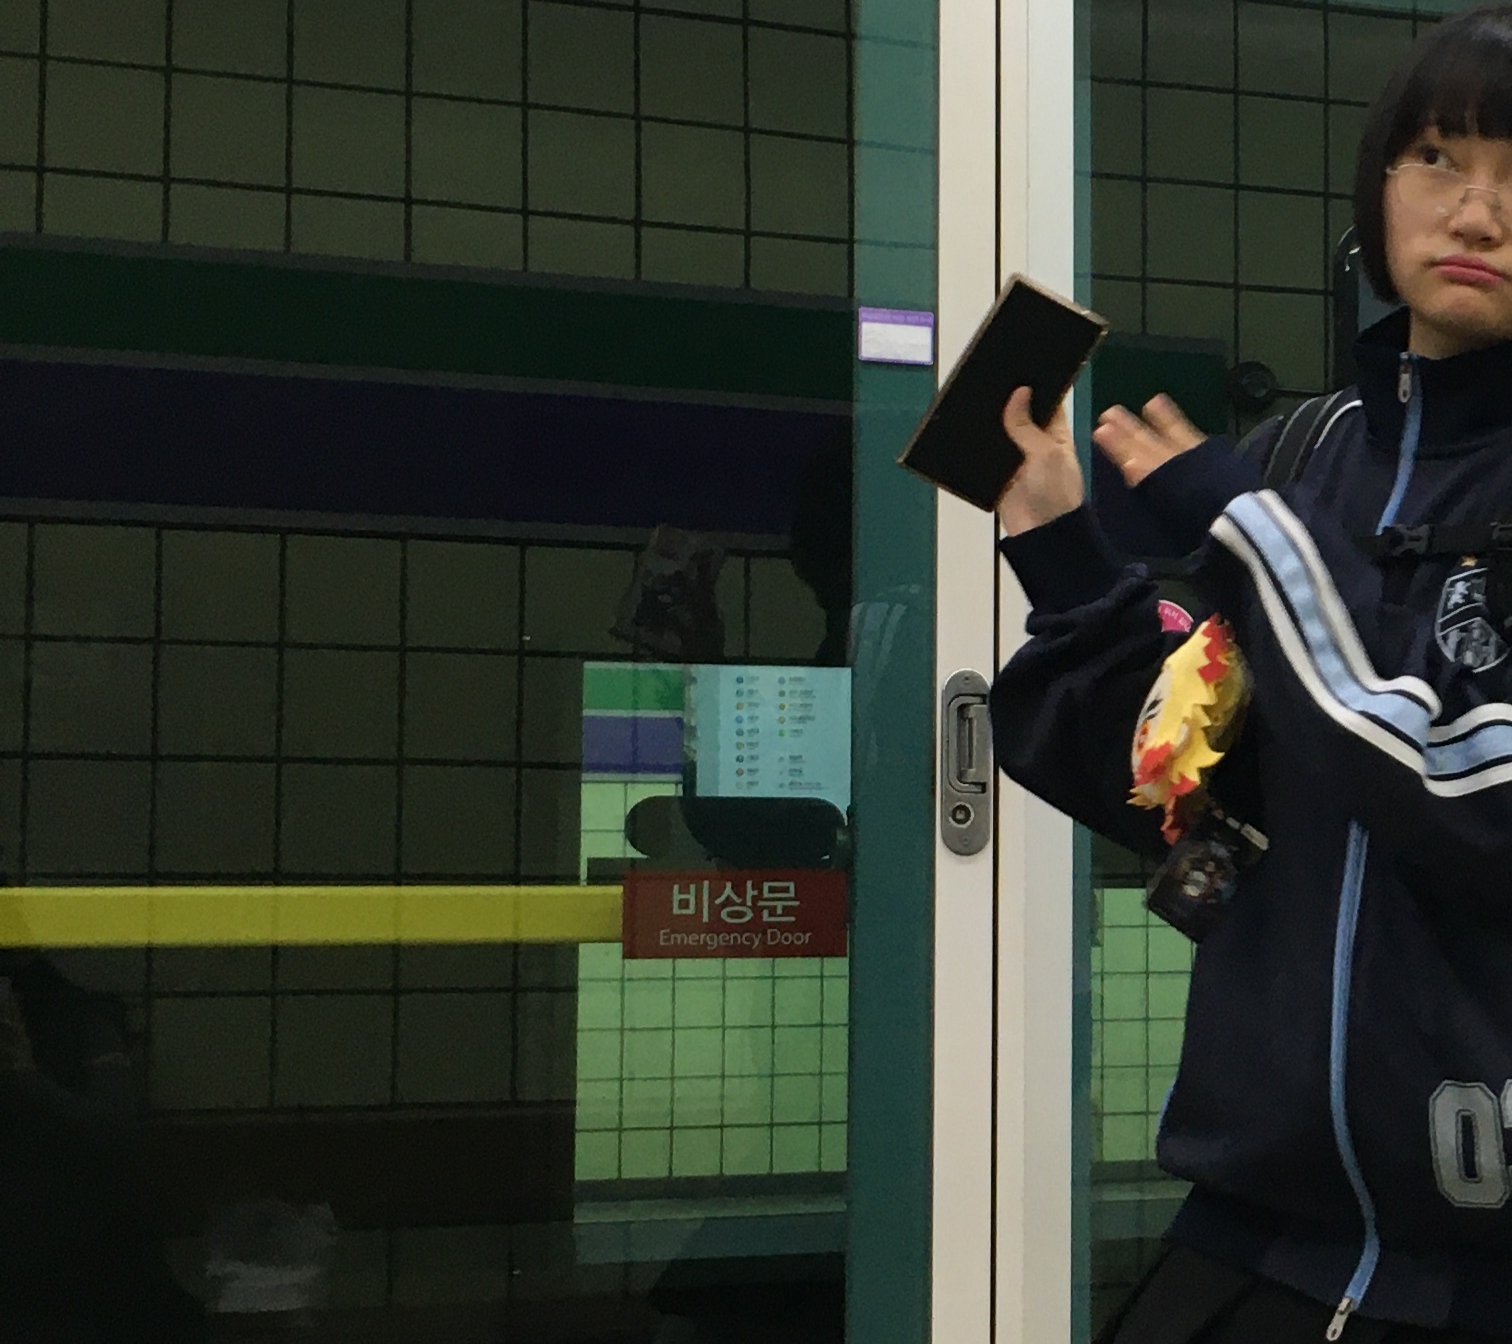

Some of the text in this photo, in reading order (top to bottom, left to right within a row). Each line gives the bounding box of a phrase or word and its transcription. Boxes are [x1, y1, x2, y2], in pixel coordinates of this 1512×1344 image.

[672, 880, 800, 924] 비상문
[659, 928, 813, 951] Emergency Door
